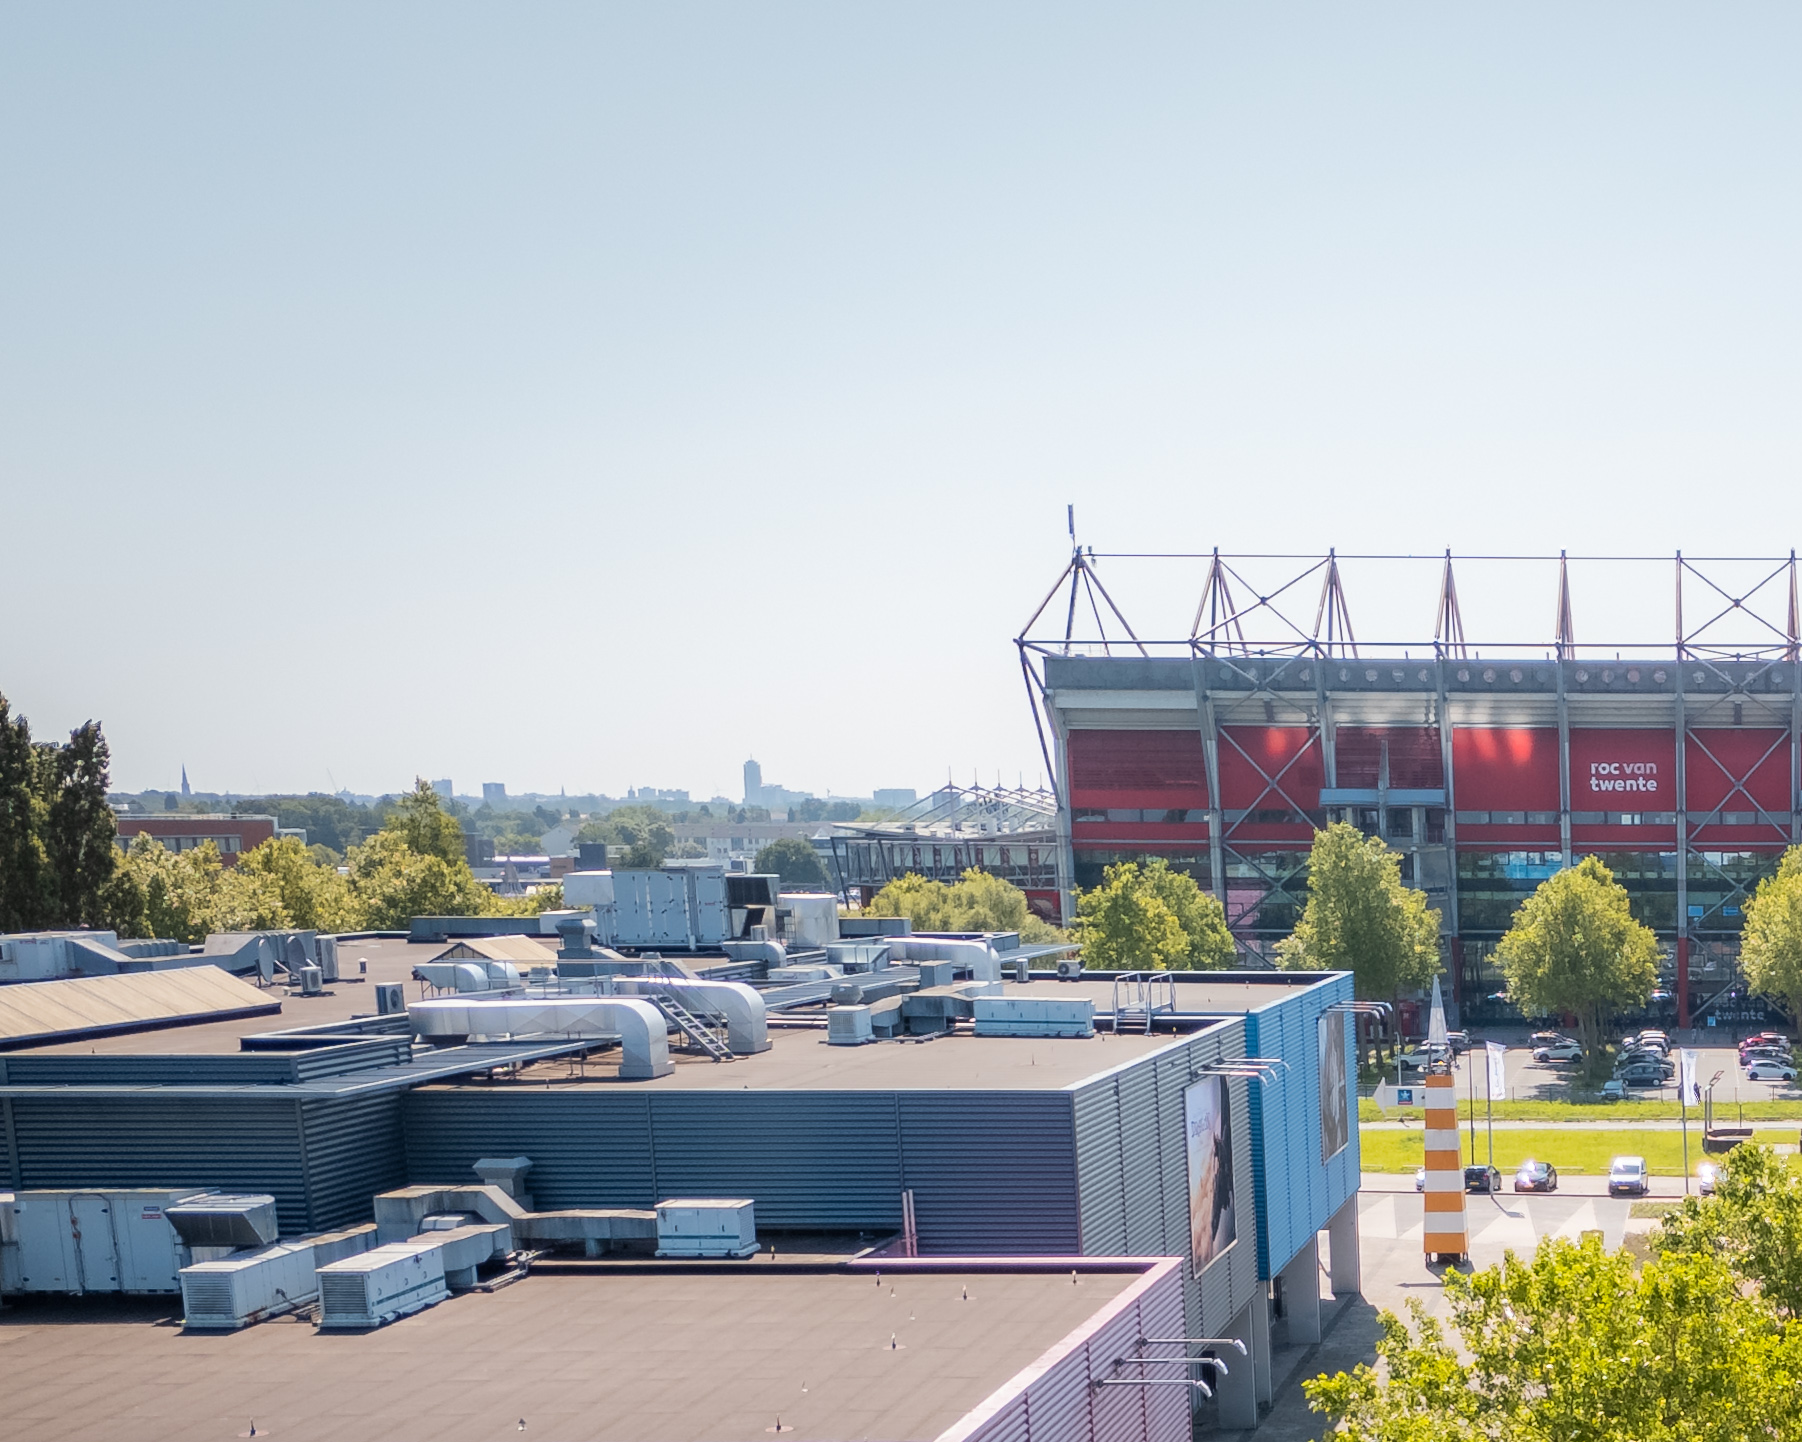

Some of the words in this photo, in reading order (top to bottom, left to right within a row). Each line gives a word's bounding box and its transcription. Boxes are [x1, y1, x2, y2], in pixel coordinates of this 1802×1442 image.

[1590, 762, 1620, 775] roc
[1622, 762, 1657, 775] van
[1589, 776, 1658, 792] twente
